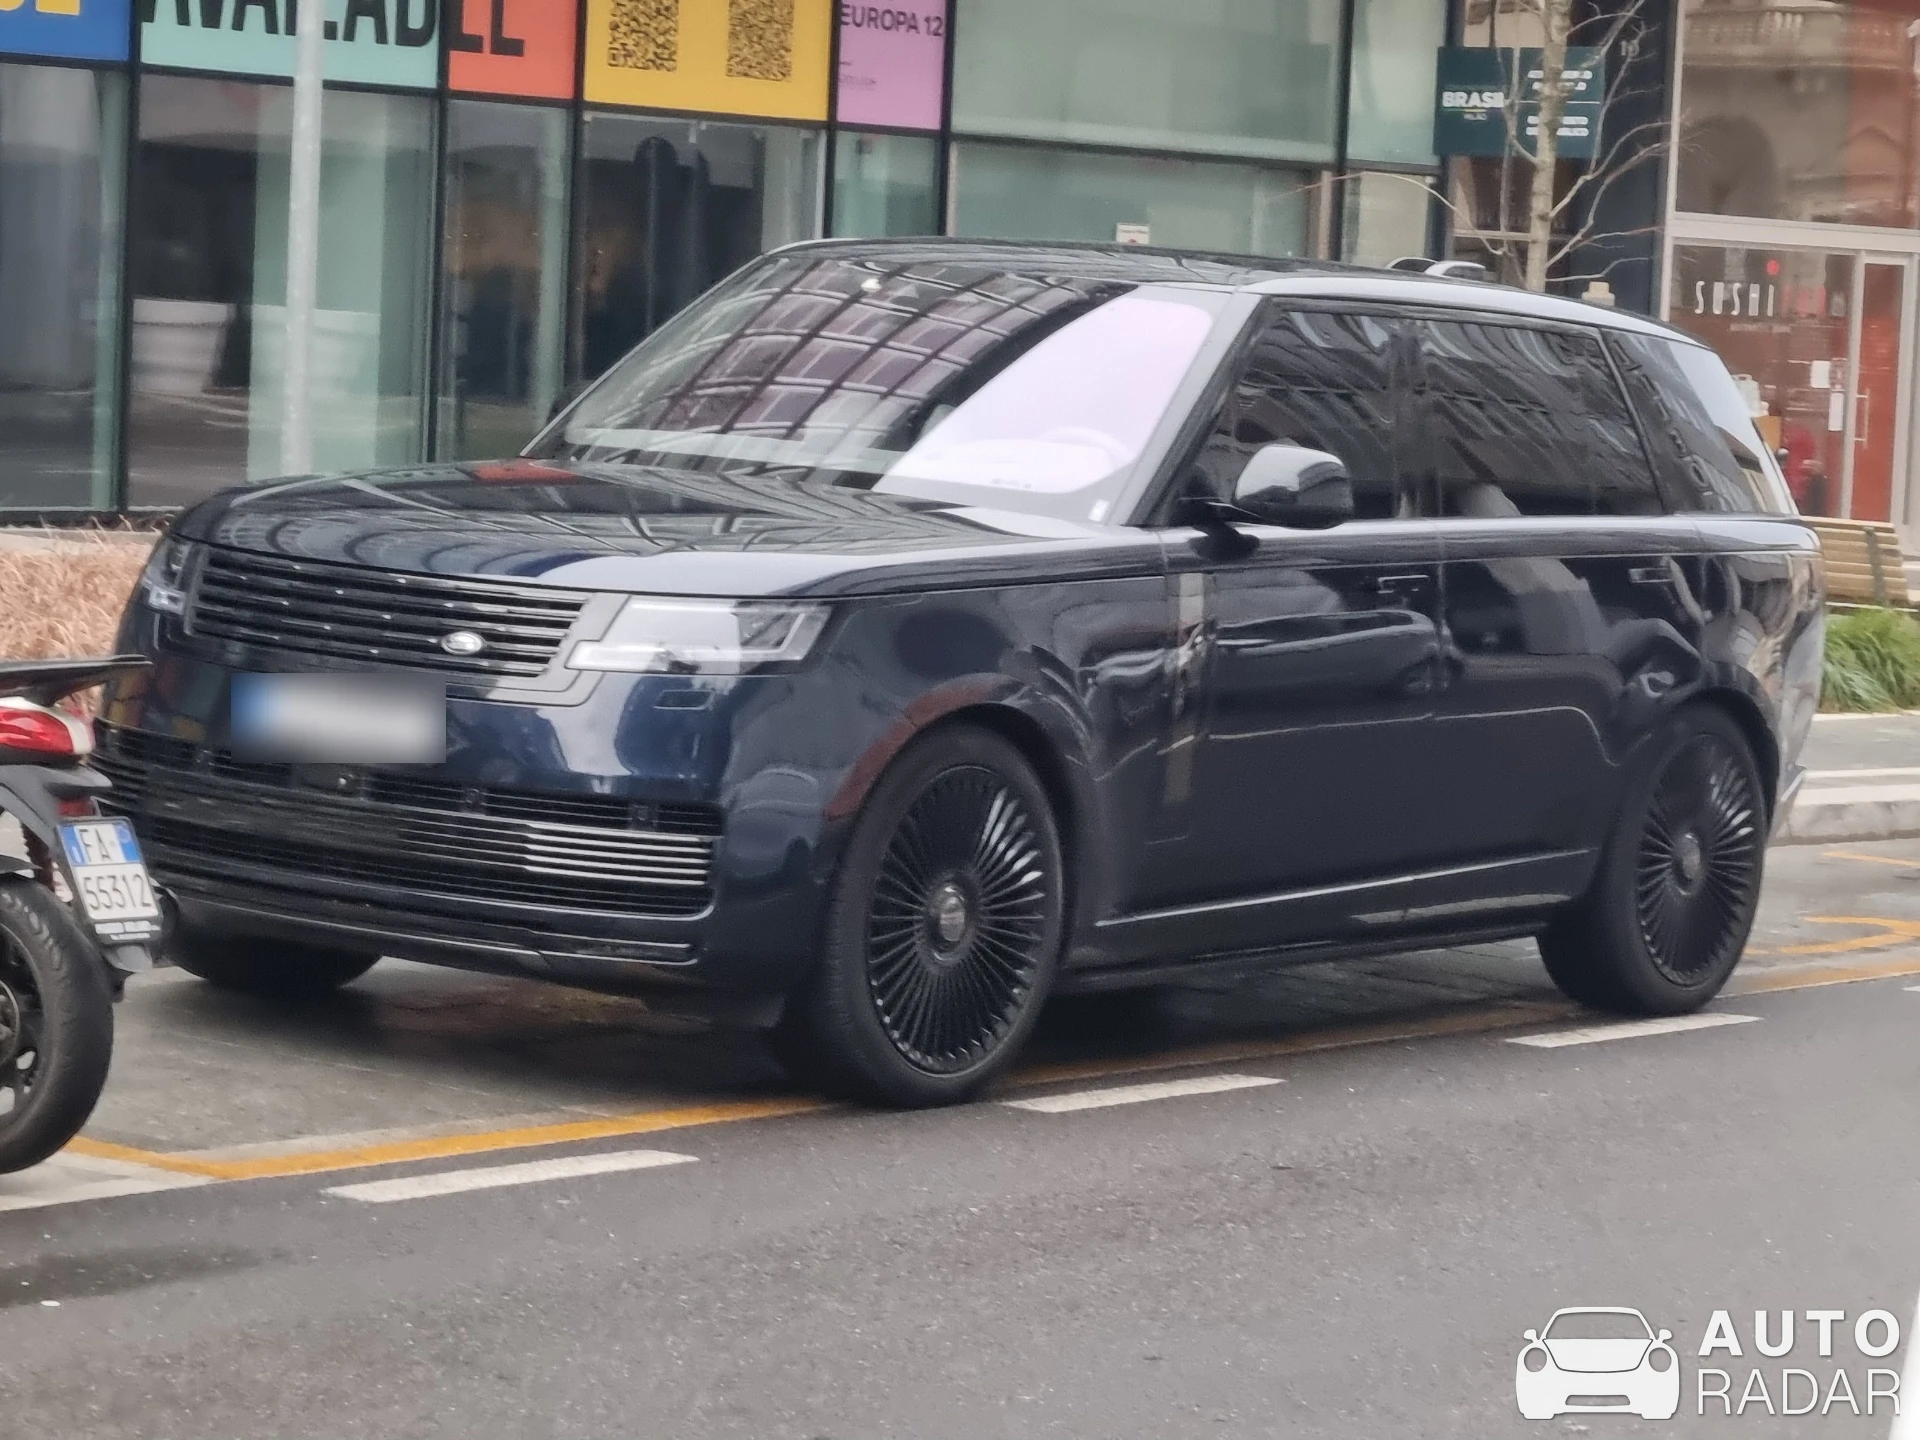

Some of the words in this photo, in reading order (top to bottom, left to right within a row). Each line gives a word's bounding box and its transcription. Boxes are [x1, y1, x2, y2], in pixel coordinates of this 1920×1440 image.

[841, 3, 920, 35] EUROPA
[925, 15, 943, 37] 12
[1694, 280, 1775, 317] SUSHI
[79, 828, 112, 863] FA
[83, 873, 152, 910] 55312
